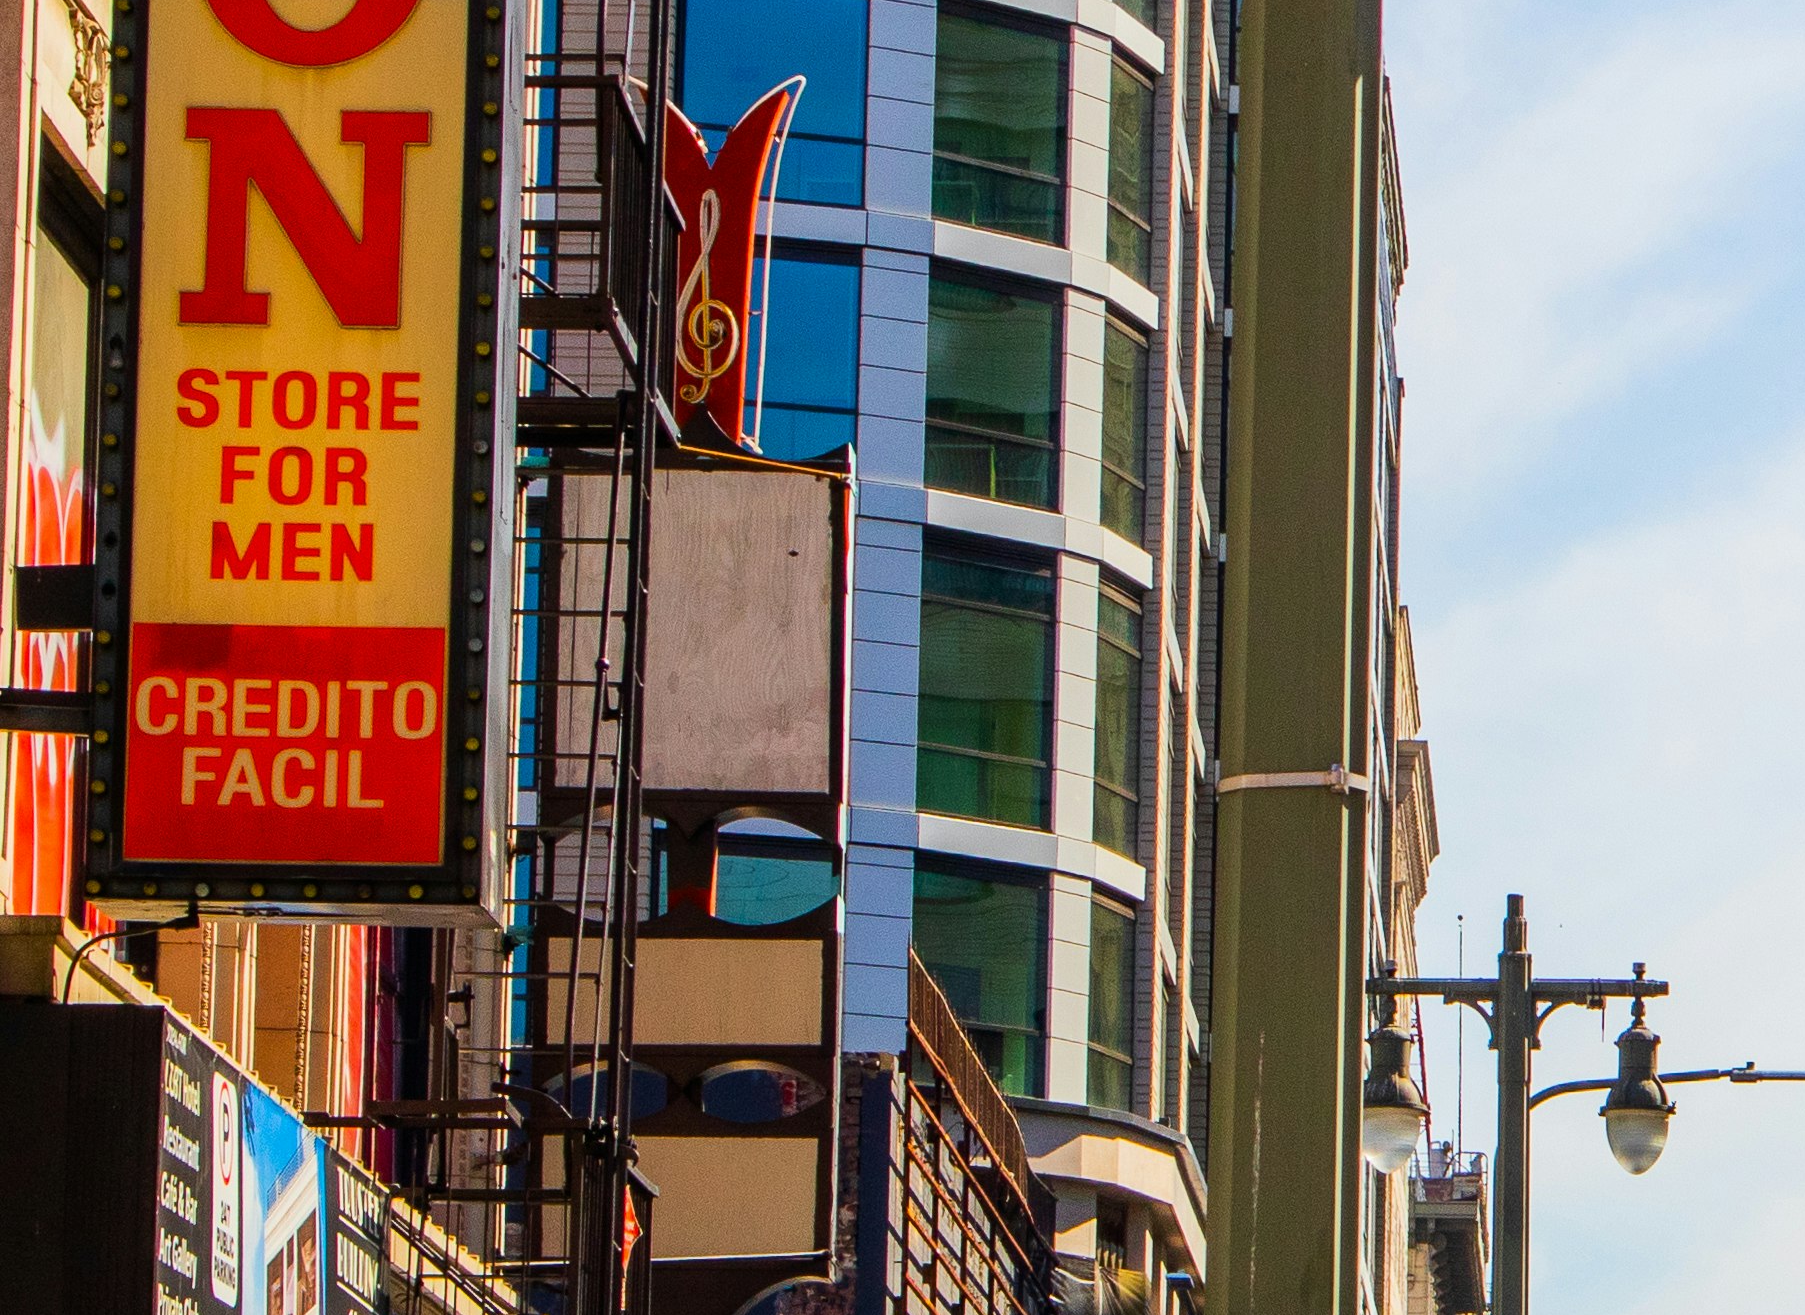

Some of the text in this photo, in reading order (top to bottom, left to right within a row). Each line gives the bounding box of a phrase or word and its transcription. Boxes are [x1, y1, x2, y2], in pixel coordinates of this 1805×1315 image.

[176, 368, 421, 431] STORE
[219, 446, 368, 506] FOR
[209, 521, 374, 581] MEN
[135, 676, 437, 740] CREDITO
[181, 747, 384, 809] FACIL
[178, 1181, 185, 1218] &
[185, 1186, 198, 1226] Bar
[158, 1227, 198, 1289] Art Gallery
